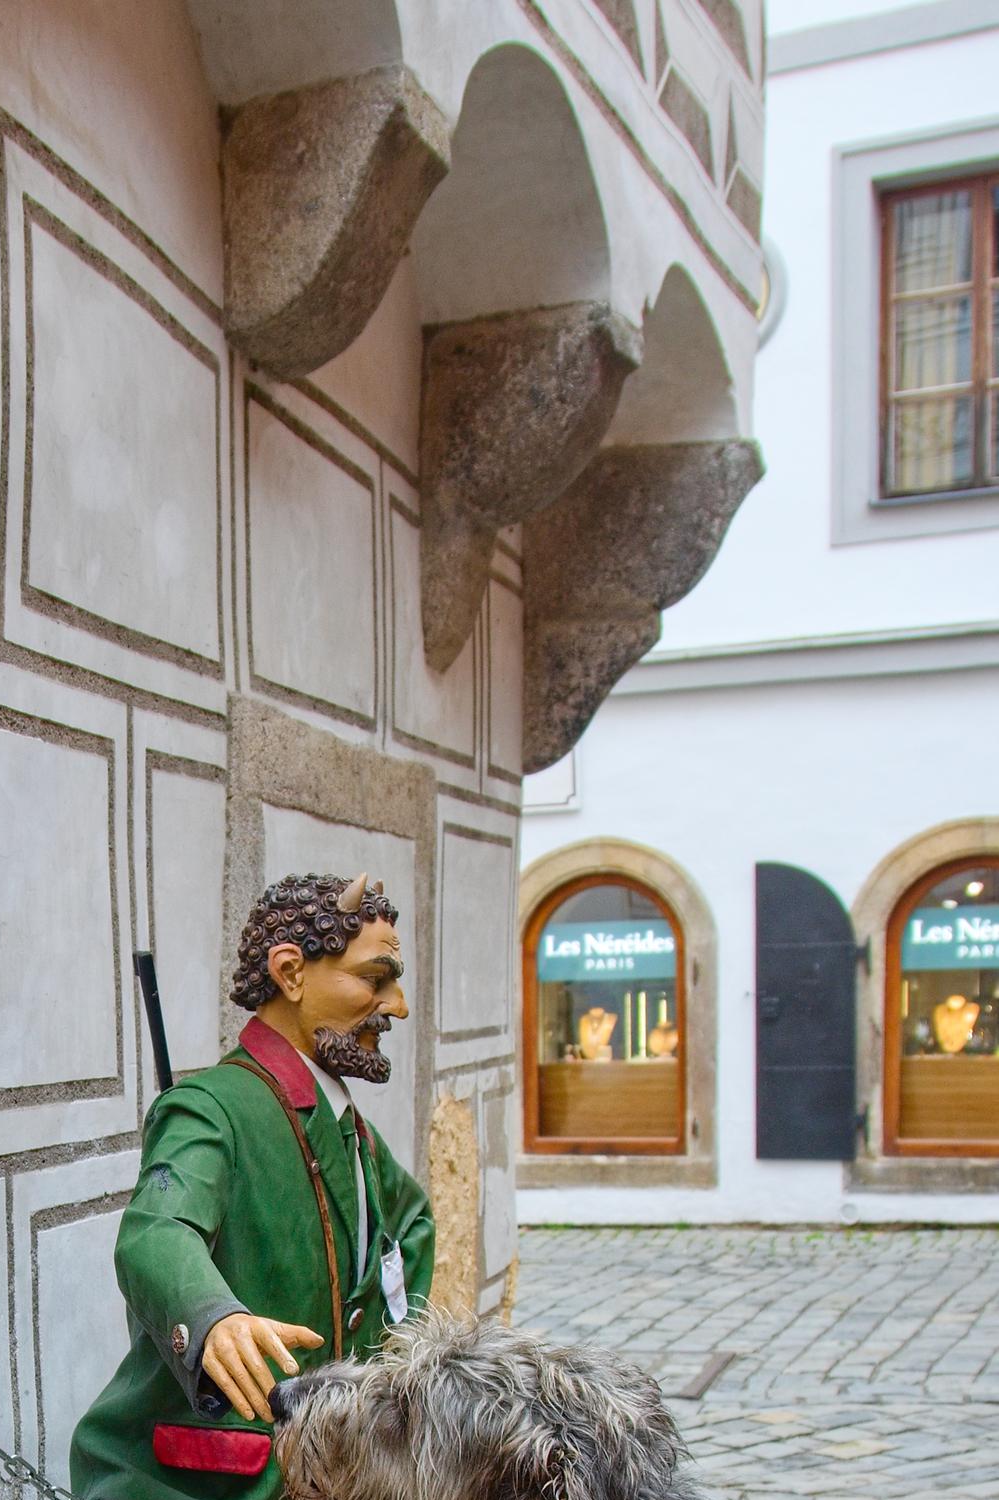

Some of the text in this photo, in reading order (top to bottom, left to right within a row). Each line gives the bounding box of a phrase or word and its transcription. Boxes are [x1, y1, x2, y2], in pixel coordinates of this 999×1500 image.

[545, 930, 675, 957] Les Néréides
[911, 919, 953, 944] Les
[584, 957, 635, 970] PARIS
